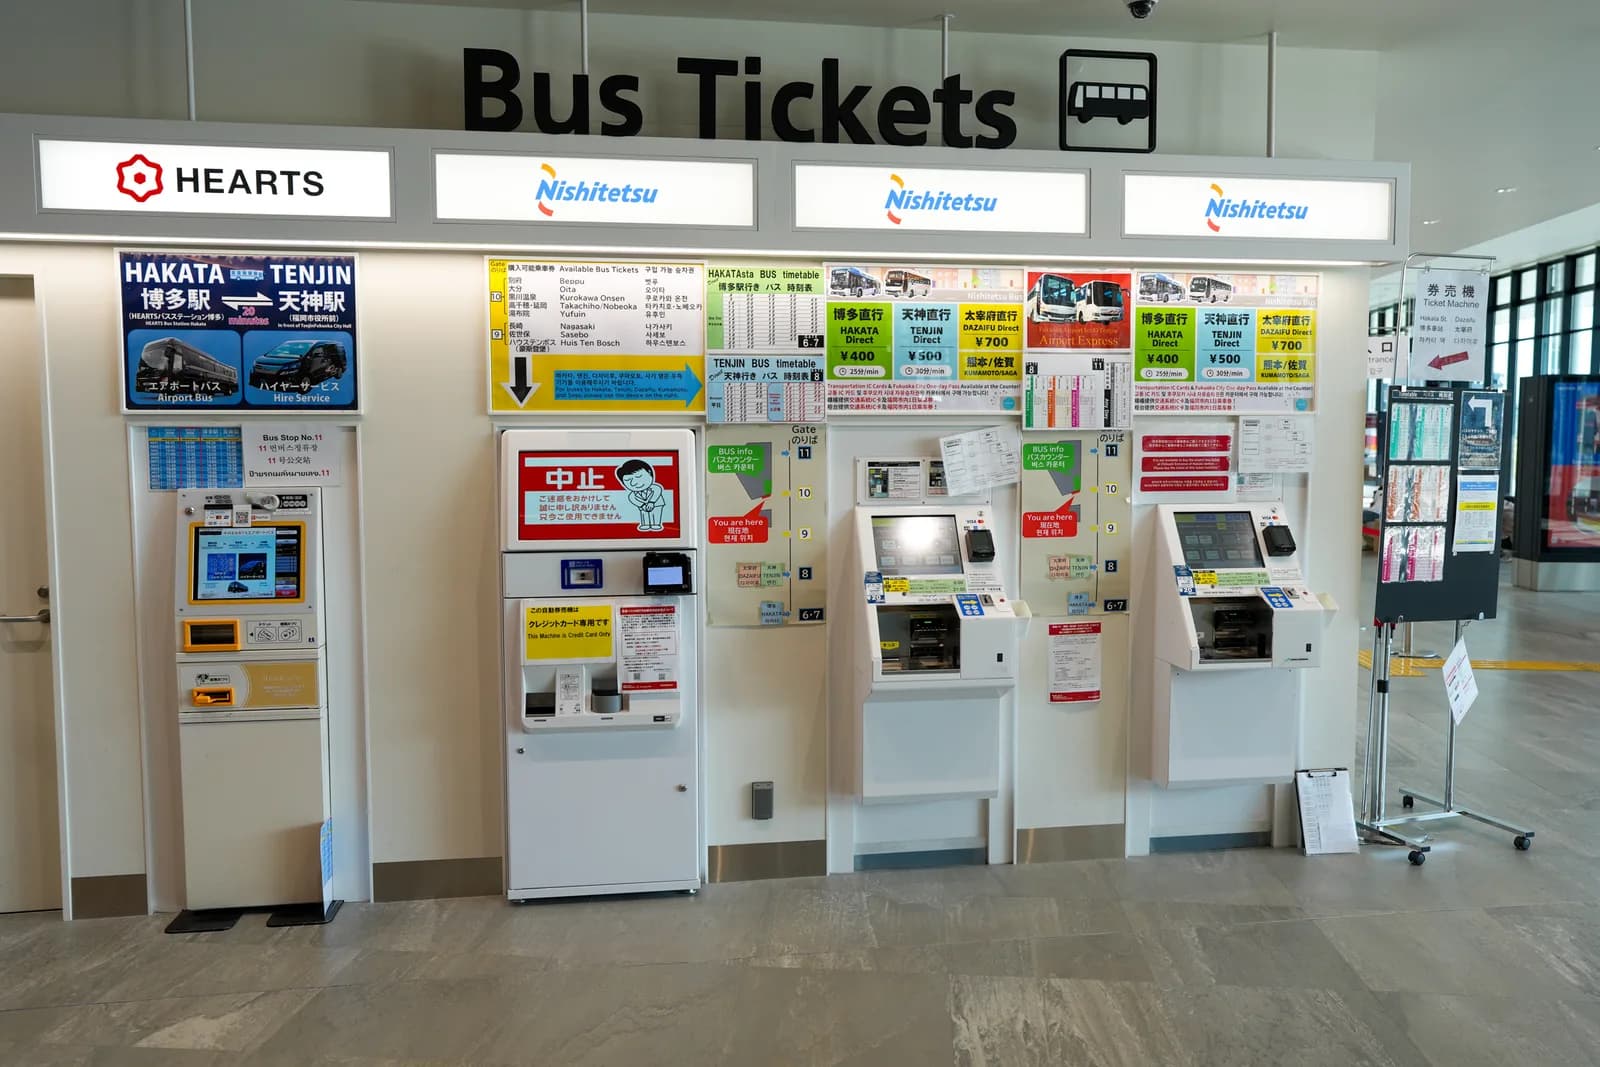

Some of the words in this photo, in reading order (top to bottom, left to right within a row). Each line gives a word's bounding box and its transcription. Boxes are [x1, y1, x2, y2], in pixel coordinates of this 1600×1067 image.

[463, 47, 643, 137] Bus
[677, 56, 1017, 149] Tickets
[176, 167, 325, 197] HEARTS
[535, 178, 658, 205] Nishitetsu
[884, 187, 998, 213] Nishitetsu
[1205, 197, 1308, 221] Nishitetsu
[125, 262, 225, 284] HAKATA
[559, 265, 594, 273] Available
[612, 266, 639, 274] Tickets
[270, 264, 352, 285] TENJIN
[708, 270, 754, 279] HAKATAsta
[760, 270, 777, 279] BUS
[783, 271, 819, 279] timetable
[559, 277, 585, 286] Beppu
[508, 285, 522, 293] 大分
[559, 285, 577, 293] Oita
[645, 286, 665, 294] 오이타
[766, 283, 781, 291] バス
[787, 283, 813, 292] 時刻表
[140, 288, 211, 311] 博多駅
[278, 291, 346, 312] 天神駅
[559, 294, 598, 302] Kurokawa
[600, 294, 625, 302] Onsen
[559, 302, 638, 310] Takachiho/Nobeoka
[1424, 298, 1446, 307] Ticket
[1447, 299, 1480, 309] Machine
[242, 306, 256, 317] 20
[560, 310, 586, 318] Yufuin
[833, 308, 884, 321] 博多直行
[902, 308, 951, 321] 天神直行
[965, 310, 1017, 322] 太宰府直行
[228, 316, 269, 326] minutes
[1142, 313, 1188, 326] 博多直行
[1204, 313, 1250, 326] 天神直行
[1262, 315, 1312, 326] 太宰府直行
[560, 323, 595, 331] Nagasaki
[645, 323, 673, 331] 나가사키
[840, 326, 879, 335] HAKATA
[911, 326, 943, 335] TENJIN
[963, 324, 996, 332] DAZAIFU
[998, 324, 1019, 332] Direct
[509, 330, 530, 338] 佐世保
[560, 331, 589, 339] Sasebo
[1147, 330, 1183, 339] HAKATA
[1212, 330, 1242, 339] TENJIN
[560, 339, 577, 347] Huis
[579, 339, 595, 347] Ten
[596, 339, 620, 347] Bosch
[845, 335, 874, 344] Direct
[913, 335, 941, 344] Direct
[975, 337, 1008, 347] ¥700
[1039, 335, 1075, 347] Airport
[1078, 335, 1118, 348] Express
[1152, 339, 1178, 348] Direct
[1214, 339, 1240, 347] Direct
[1271, 340, 1302, 351] ¥700
[840, 351, 875, 361] ¥400
[908, 351, 942, 361] ¥500
[1147, 354, 1179, 364] ¥400
[1209, 354, 1241, 364] ¥500
[714, 359, 745, 368] TENJIN
[751, 359, 770, 368] BUS
[776, 359, 816, 369] timetable
[966, 356, 1015, 368] 熊本/佐賀
[1093, 361, 1102, 370] 11
[1263, 359, 1307, 371] 熊本/佐賀
[850, 367, 879, 376] 25分/min
[1029, 365, 1035, 373] 8
[724, 372, 756, 380] 天神行き
[762, 372, 778, 380] バス
[814, 372, 820, 380] 8
[150, 382, 221, 392] エアポートバス
[260, 382, 340, 392] ハイヤーサービス
[158, 393, 193, 403] Airport
[194, 394, 213, 402] Bus
[273, 394, 293, 402] Hire
[295, 394, 331, 403] Service
[791, 425, 816, 434] Gate
[280, 434, 299, 442] Stop
[791, 436, 818, 445] のりば
[1100, 434, 1124, 442] のりば
[799, 449, 811, 458] 11
[1106, 446, 1117, 455] 11
[717, 463, 732, 471] 버스
[733, 463, 754, 471] 카운터
[545, 467, 605, 490] 中止
[799, 488, 811, 498] 10
[1105, 484, 1117, 493] 10
[539, 503, 617, 512] 誠に申し訳ありません
[539, 512, 622, 521] 只今ご使用できません
[1107, 524, 1114, 532] 9
[723, 534, 738, 542] 현재
[739, 534, 754, 542] 위치
[801, 530, 808, 539] 9
[1107, 561, 1114, 570] 8
[801, 569, 809, 578] 8
[529, 619, 609, 628] クレジットカード専用です
[599, 631, 611, 639] Only
